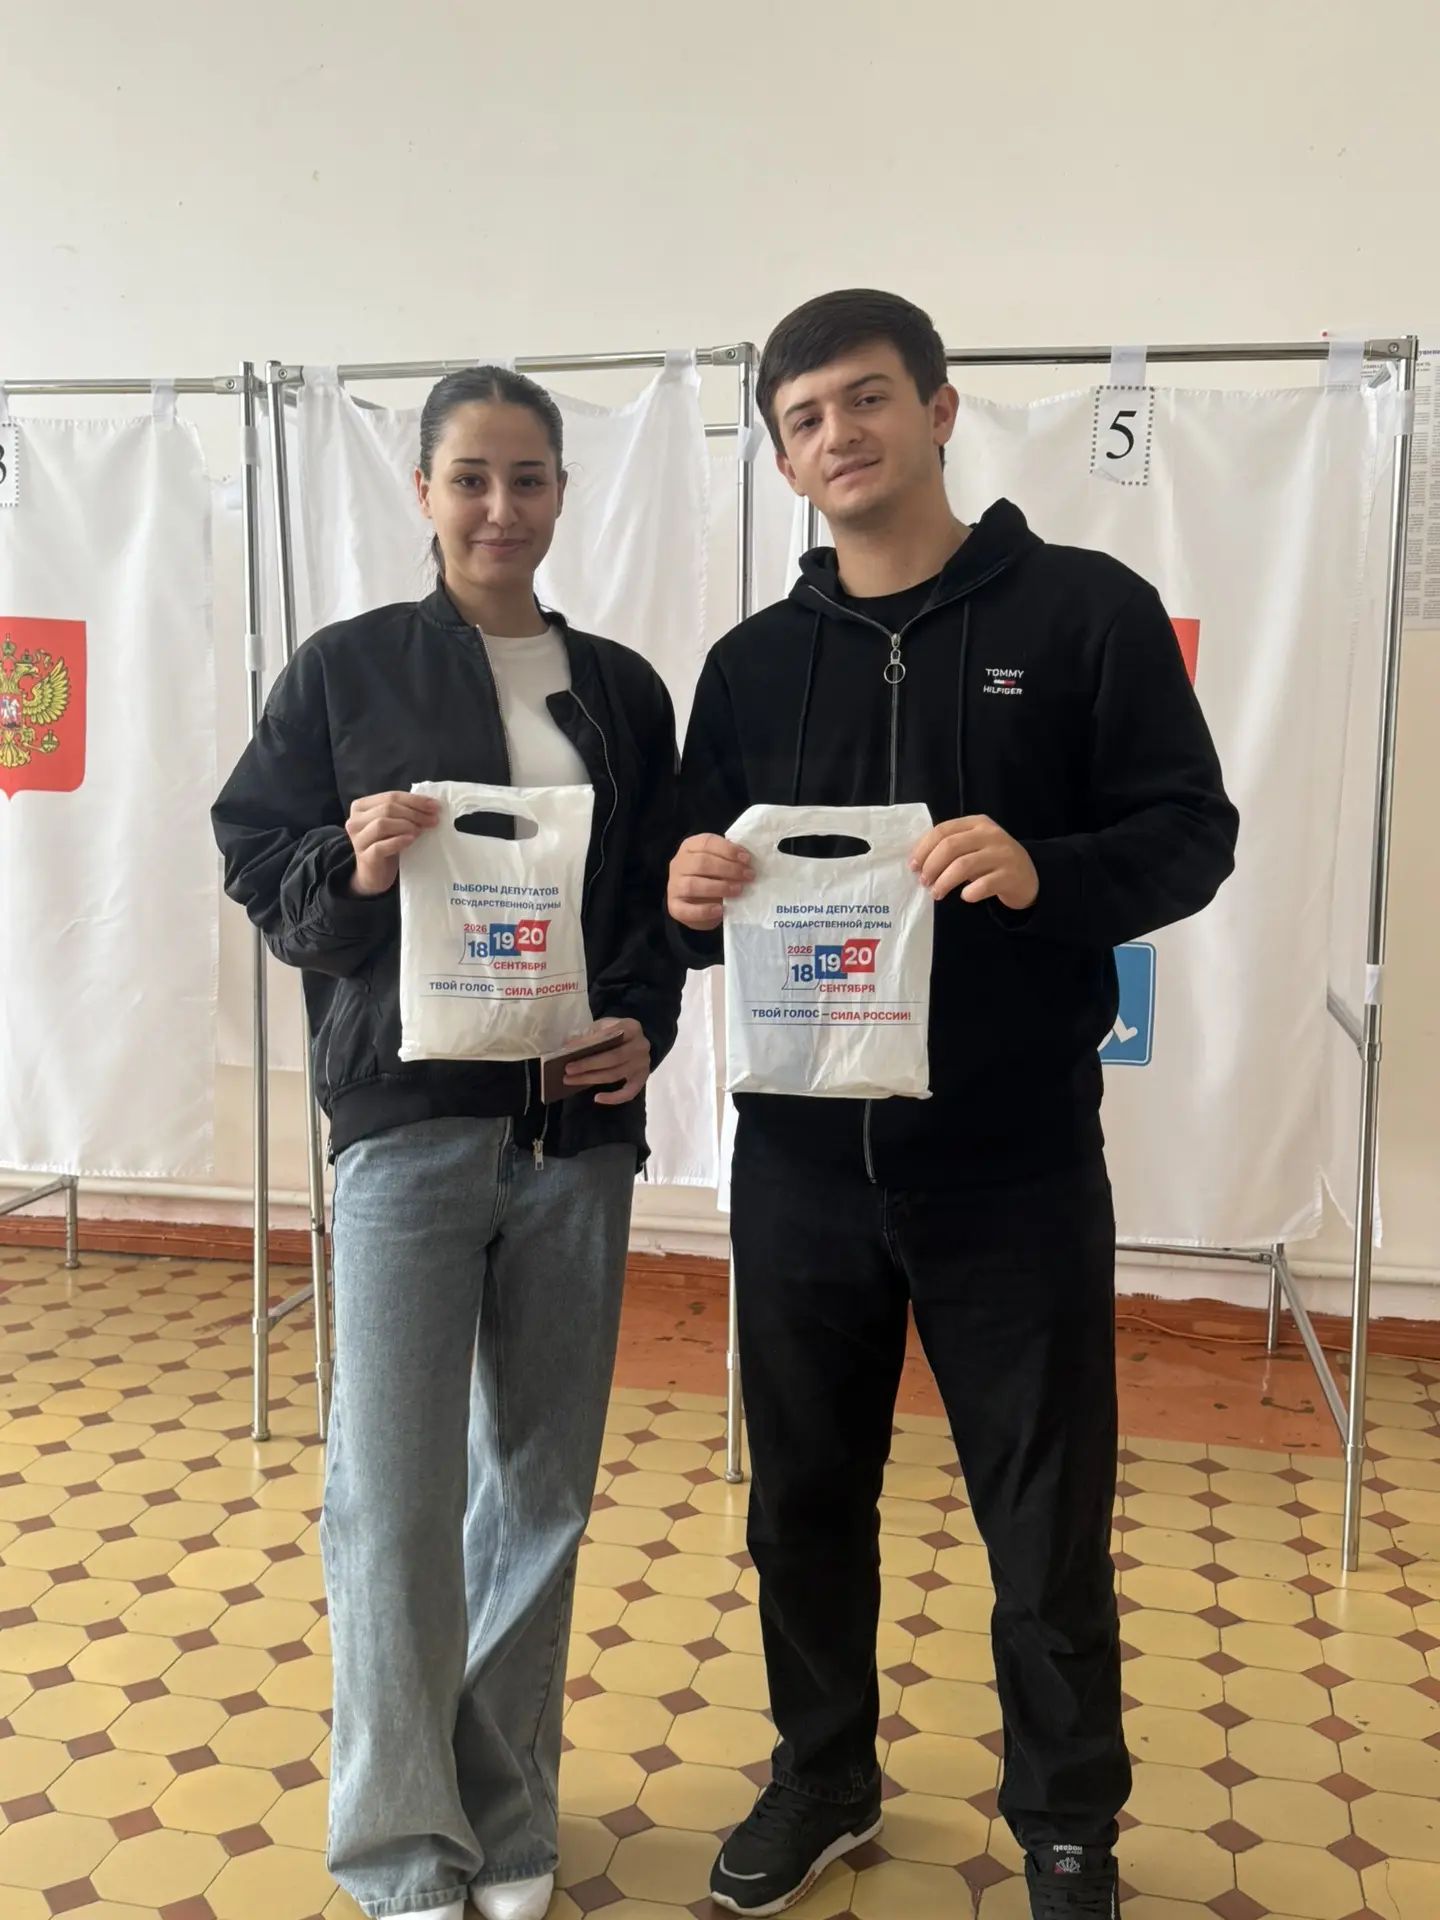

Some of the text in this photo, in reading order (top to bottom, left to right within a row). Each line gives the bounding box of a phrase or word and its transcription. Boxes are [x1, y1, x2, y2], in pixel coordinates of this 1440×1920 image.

[1106, 410, 1137, 459] 5
[985, 668, 1024, 678] TOMMY
[983, 685, 1023, 695] HILFIGER
[453, 883, 559, 896] ВЫБОРЫ ДЕПУТАТОВ
[450, 898, 561, 911] ГОСУДАРСТВЕННОЙ ДУМЫ
[776, 905, 889, 915] ВЫБОРЫ ДЕПУТАТОВ
[464, 923, 487, 933] 2026
[774, 919, 892, 929] ГОСУДАРСТВЕННОЙ ДУМЫ
[468, 927, 543, 958] 18 19 20
[787, 945, 813, 954] 2026
[493, 961, 547, 971] СЕНТЯБРЯ
[791, 947, 872, 982] 18 19 20
[430, 980, 457, 991] ТВОЙ
[460, 982, 494, 992] ГОЛОС
[505, 987, 533, 996] СИЛА
[536, 983, 579, 995] РОССИИ!
[819, 984, 875, 993] СЕНТЯБРЯ
[752, 1008, 781, 1018] ТВОЙ
[784, 1009, 819, 1018] ГОЛОС
[830, 1011, 860, 1020] СИЛА
[863, 1011, 911, 1021] РОССИИ!
